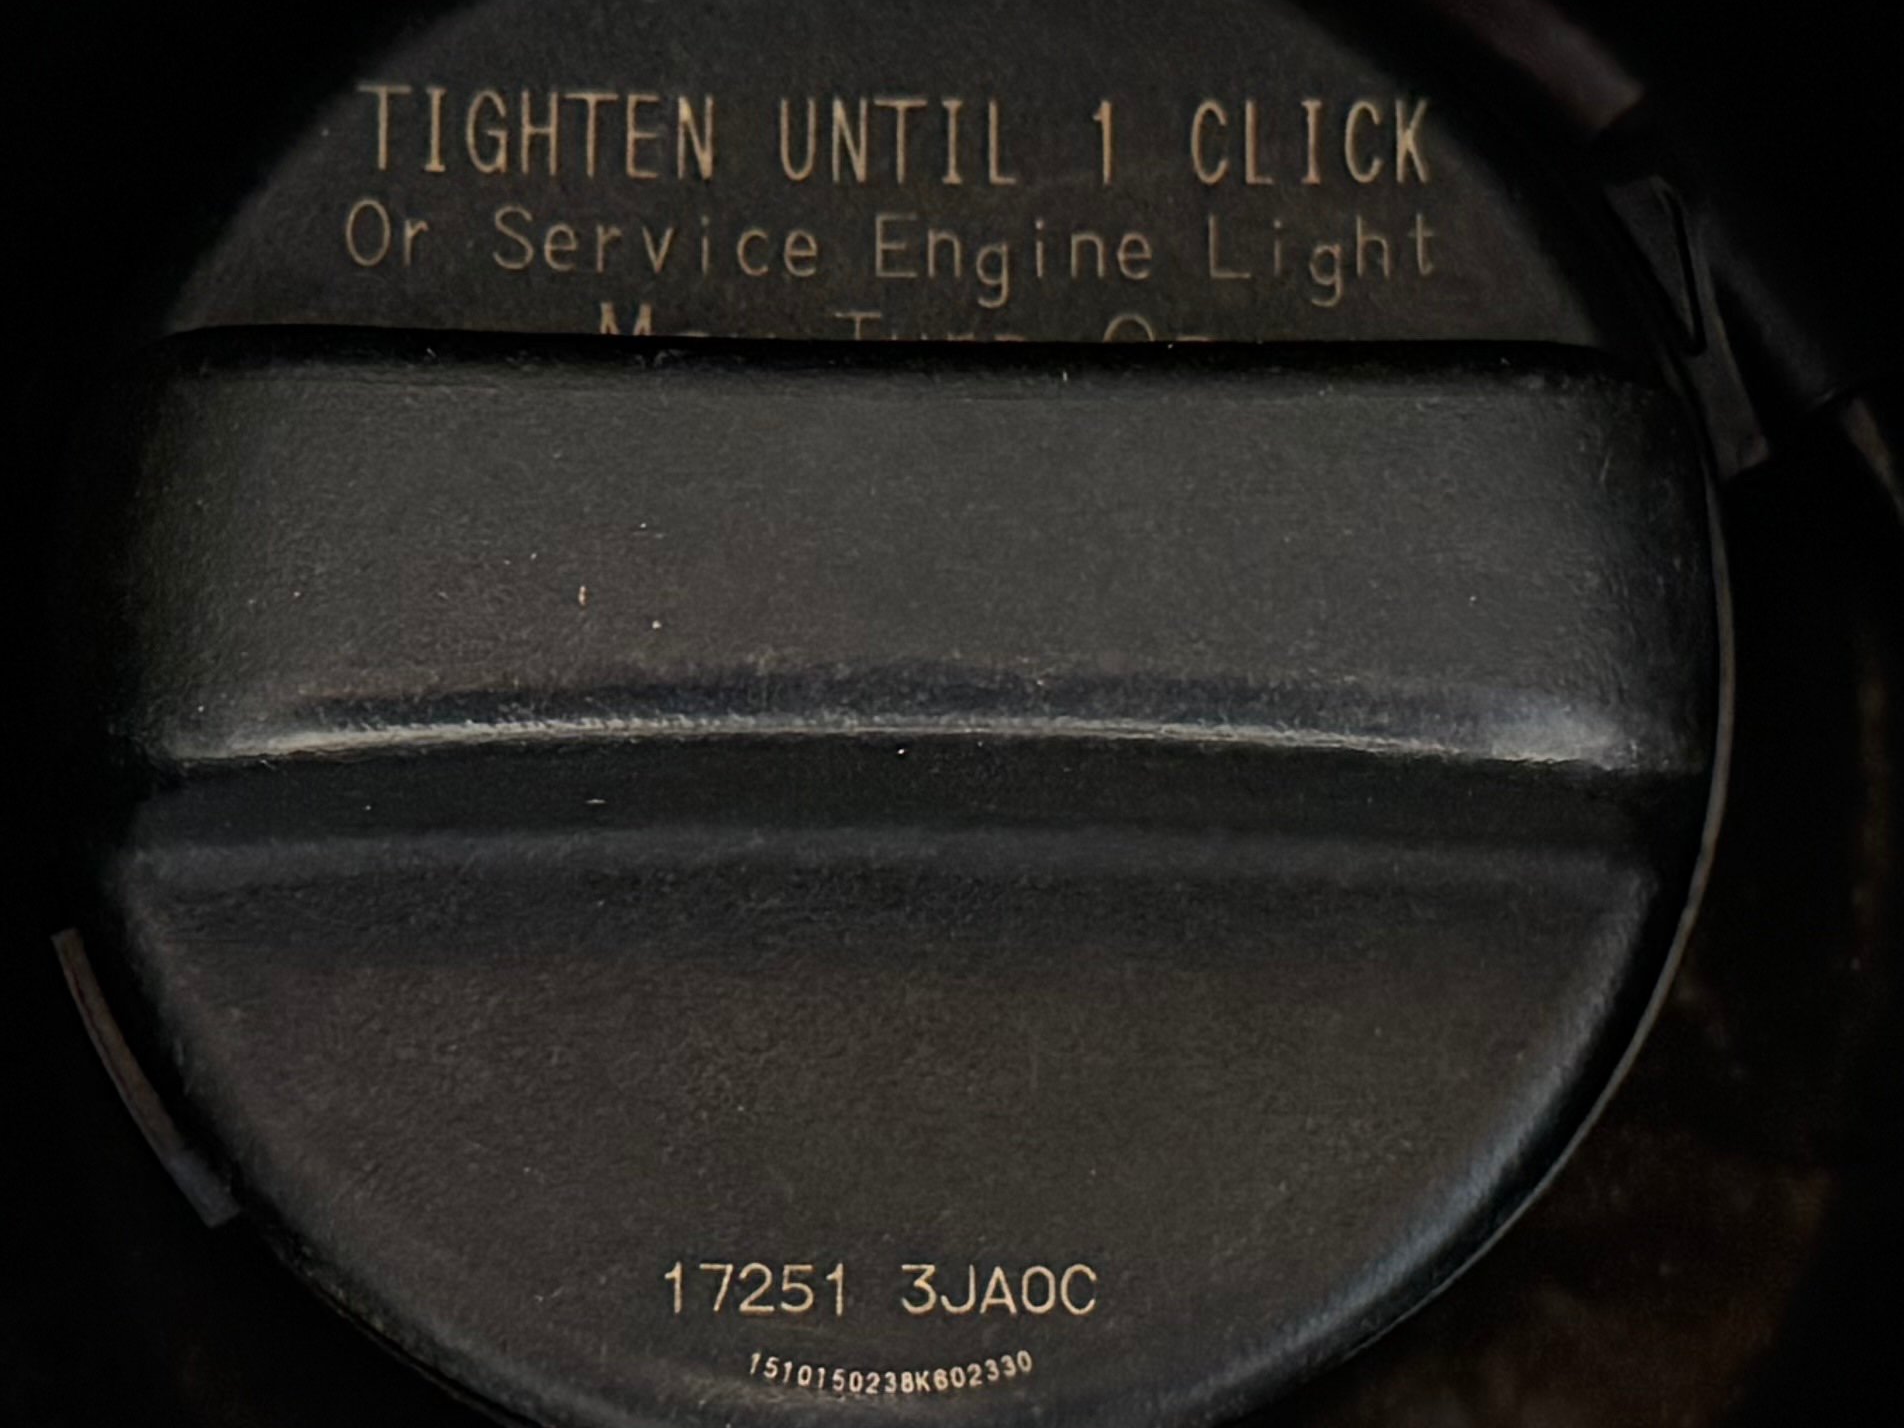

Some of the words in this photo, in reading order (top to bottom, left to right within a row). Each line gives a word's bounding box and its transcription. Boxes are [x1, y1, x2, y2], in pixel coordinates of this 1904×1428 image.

[357, 83, 716, 180] TIGHTEN
[778, 96, 1017, 185] UNTIL
[1092, 98, 1115, 185] 1
[1190, 97, 1432, 186] CLICK
[345, 198, 429, 267] Or
[493, 205, 819, 277] Service
[875, 213, 1153, 309] Engine
[1205, 214, 1437, 307] Light
[663, 1260, 845, 1317] 17251
